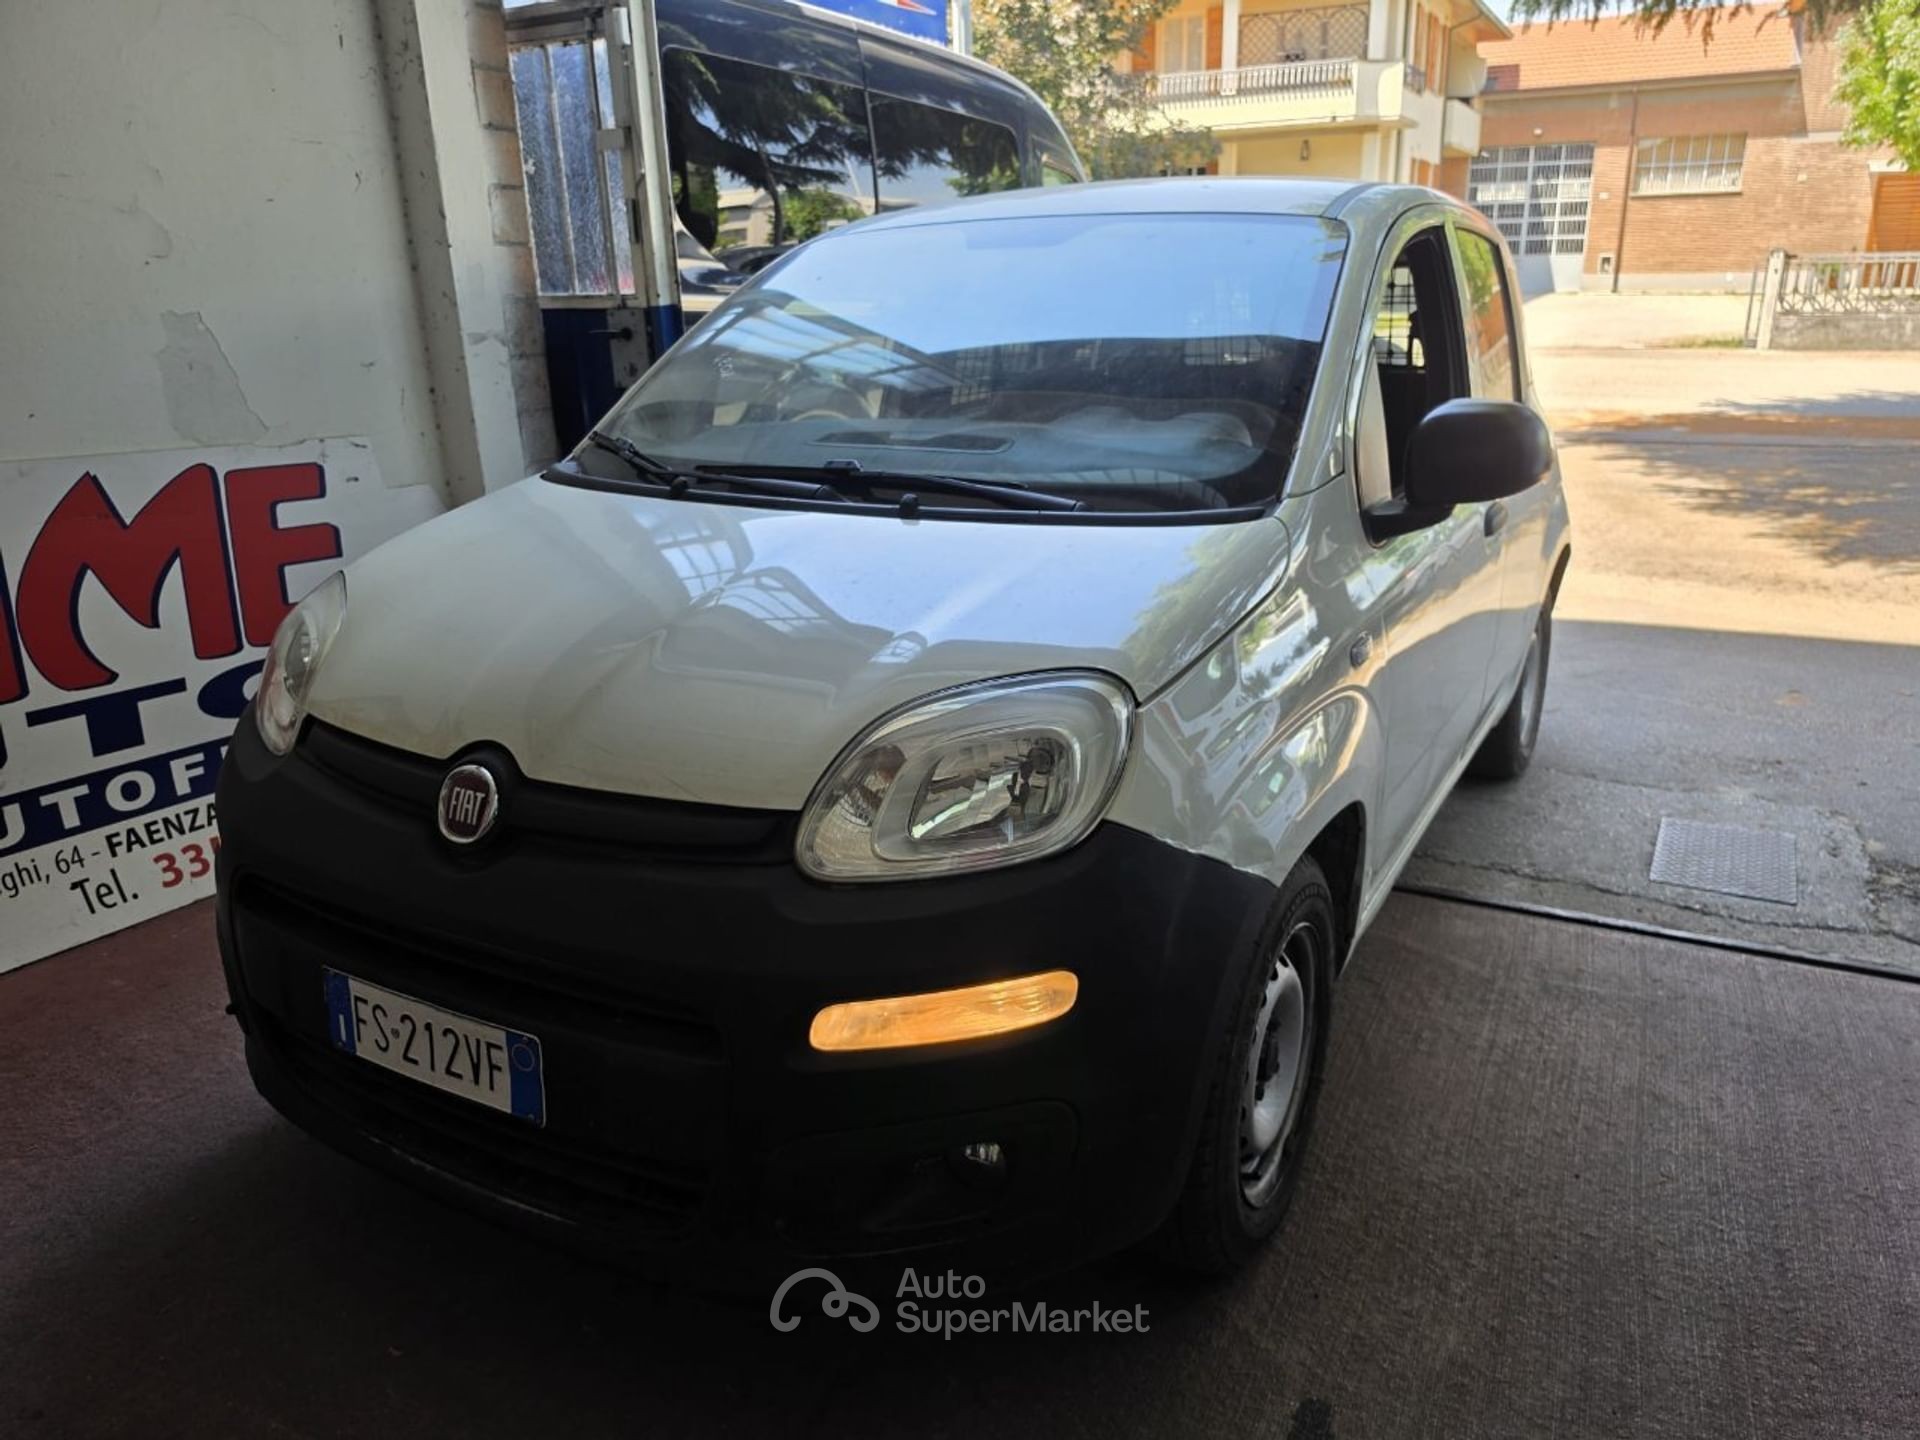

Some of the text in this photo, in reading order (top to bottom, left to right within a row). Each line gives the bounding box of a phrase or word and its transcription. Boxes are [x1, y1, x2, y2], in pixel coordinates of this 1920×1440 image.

[449, 786, 486, 826] FIAT
[0, 858, 50, 898] ghi,
[54, 845, 85, 874] 64
[105, 802, 217, 858] FAENZA
[69, 868, 139, 915] Tel.
